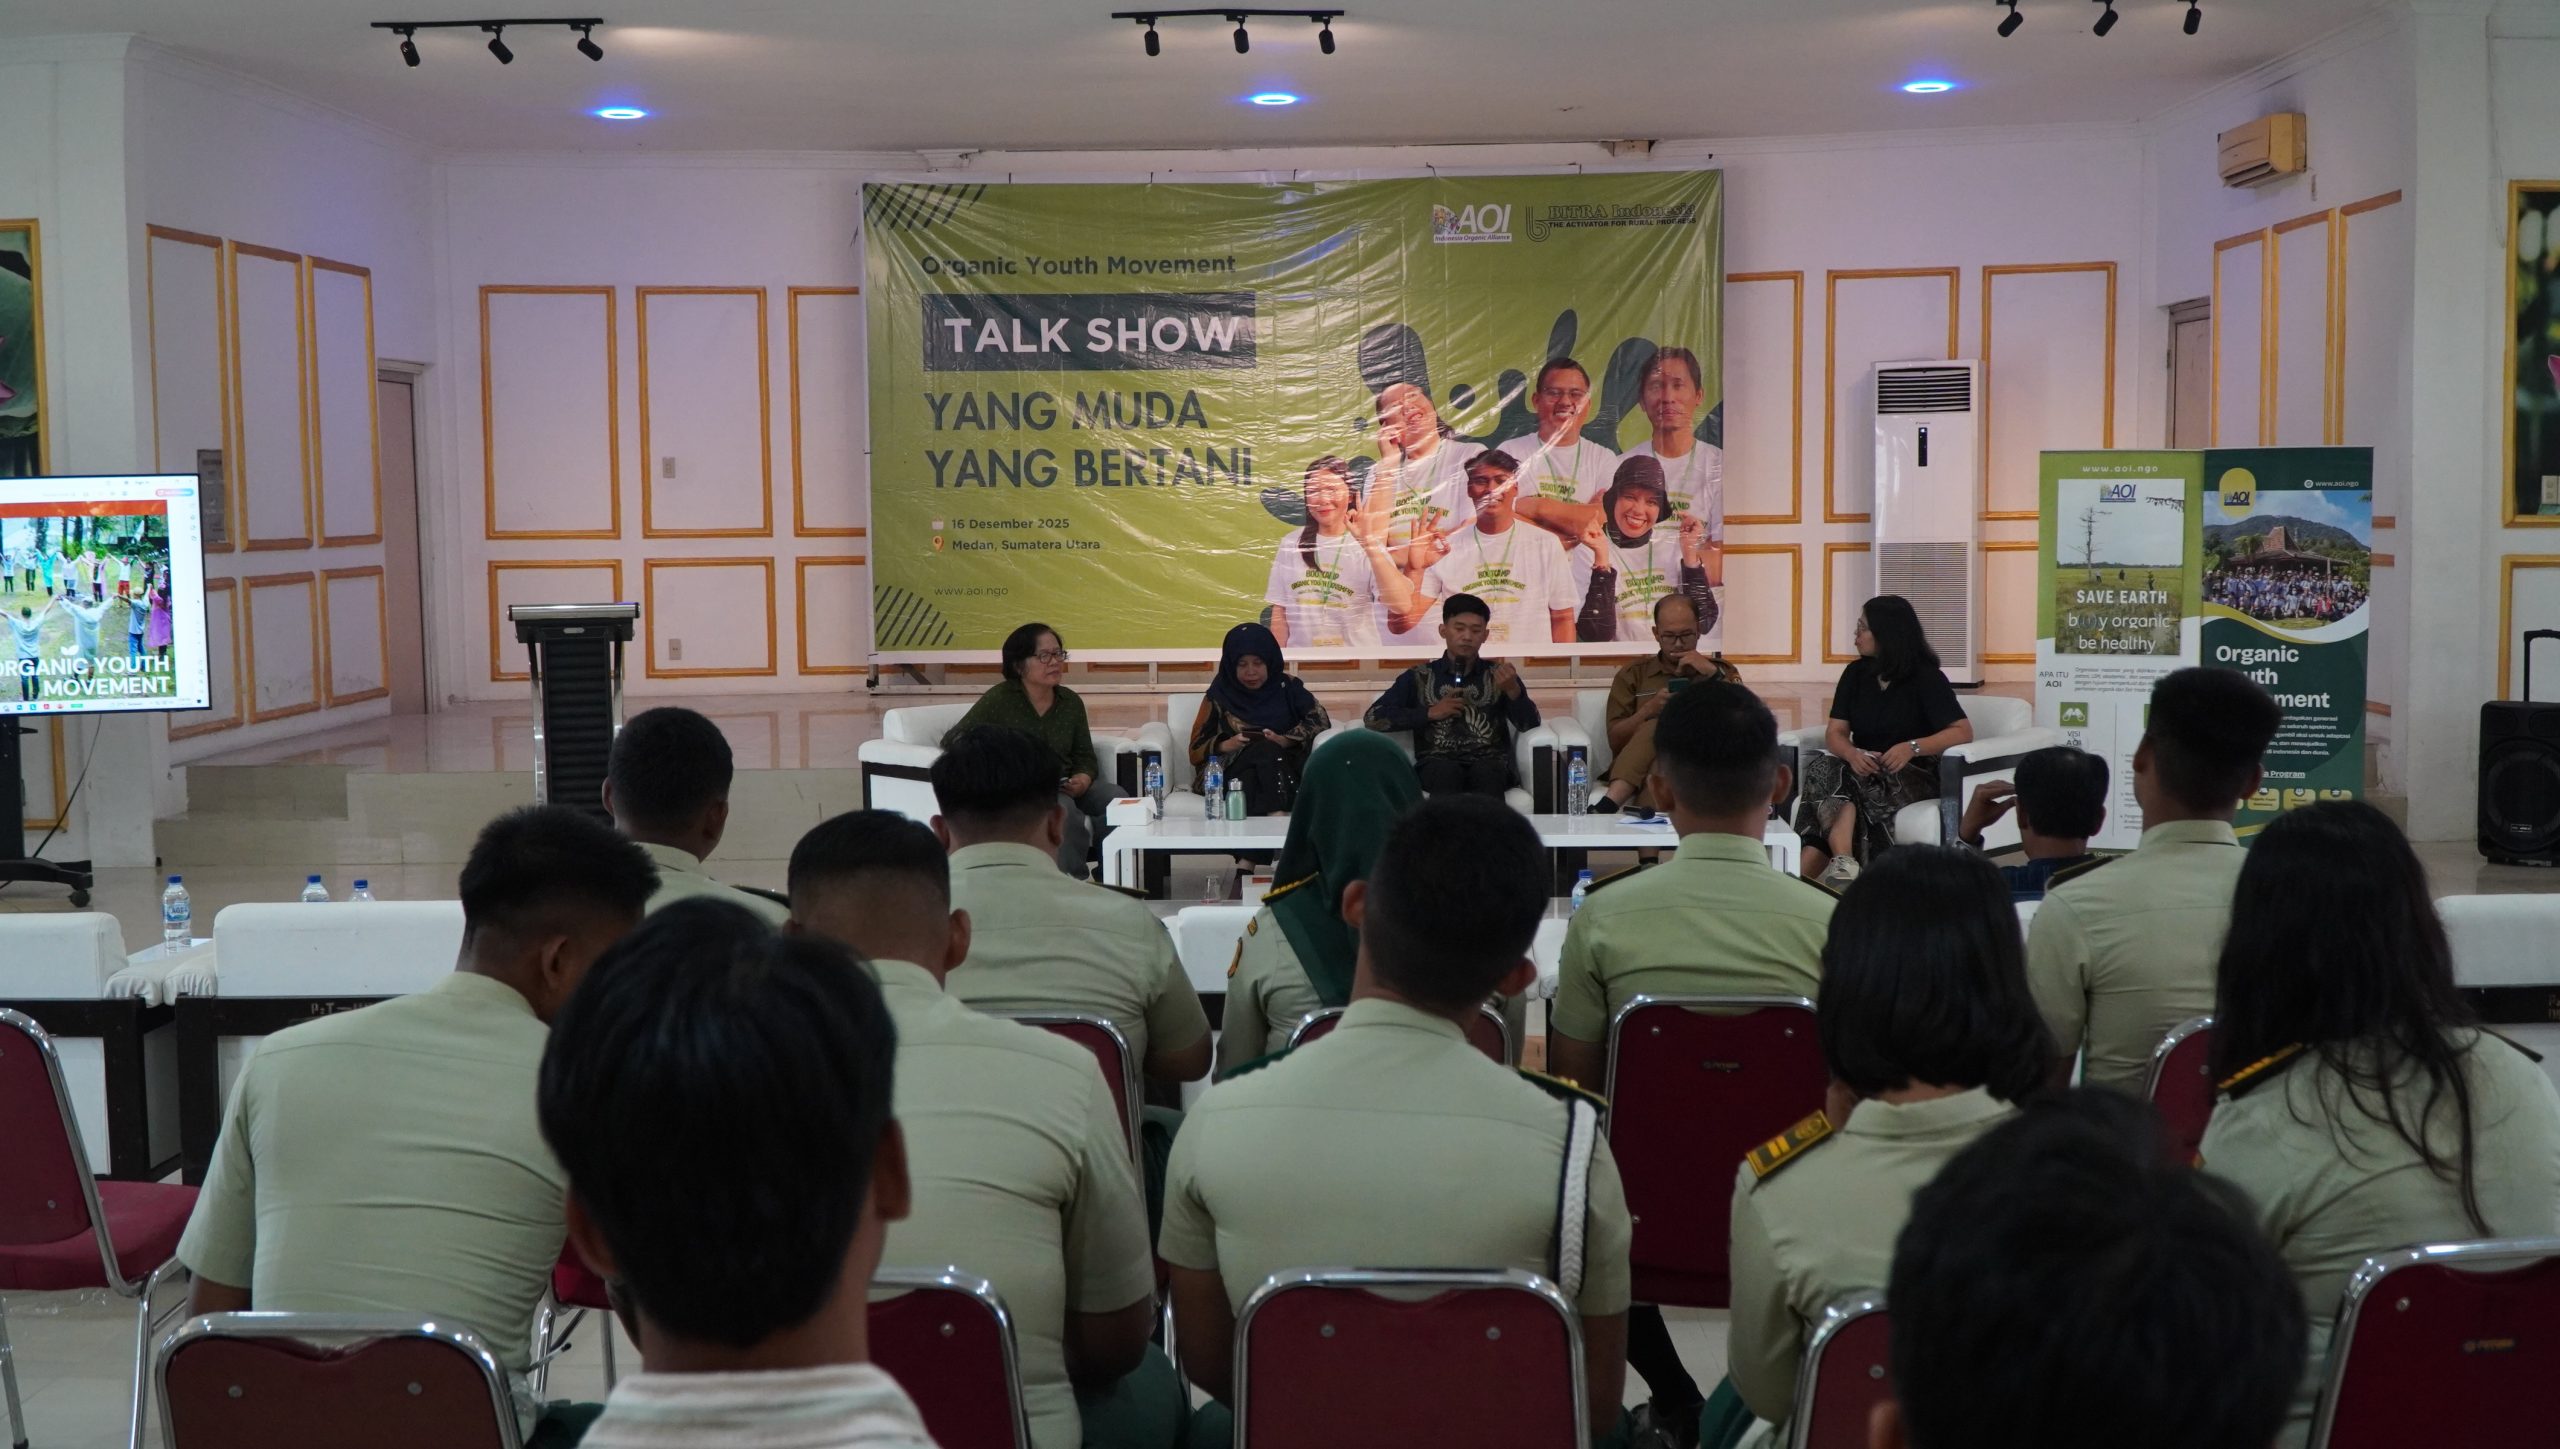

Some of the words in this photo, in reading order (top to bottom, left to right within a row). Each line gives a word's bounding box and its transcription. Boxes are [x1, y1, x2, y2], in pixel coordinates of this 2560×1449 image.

[1459, 204, 1512, 233] AOI
[1549, 205, 1608, 219] BITRA
[1566, 220, 1609, 228] ACTIVATOR
[1611, 219, 1627, 227] FOR
[921, 256, 1018, 277] Organic
[1025, 256, 1098, 274] Youth
[1108, 255, 1236, 275] Movement
[944, 317, 1072, 353] TALK
[1086, 317, 1240, 353] SHOW
[924, 391, 1057, 431] YANG
[1072, 389, 1209, 430] MUDA
[924, 448, 1058, 488] YANG
[1074, 447, 1252, 487] BERTANI
[2082, 465, 2158, 473] www.aoi.ngo
[2111, 484, 2137, 498] AOI
[2315, 480, 2358, 488] www.aoi.ngo
[2232, 491, 2250, 503] AOI
[952, 518, 965, 529] 16
[969, 518, 1034, 530] Desember
[1037, 518, 1070, 529] 2025
[952, 539, 998, 552] Medan,
[1002, 539, 1062, 550] Sumatera
[1066, 538, 1101, 550] Utara
[934, 585, 1009, 596] www.aoi.ngo
[2077, 590, 2114, 604] SAVE
[2120, 590, 2168, 604] EARTH
[2112, 615, 2170, 629] organic
[2079, 635, 2097, 649] be
[2100, 636, 2157, 655] healthy
[2216, 645, 2300, 665] Organic
[0, 656, 89, 678] RGANIC
[94, 655, 169, 674] YOUTH
[2039, 671, 2054, 679] APA
[2245, 668, 2279, 685] uth
[43, 676, 170, 697] MOVEMENT
[2045, 680, 2062, 688] AOI
[2274, 692, 2330, 708] ment
[2271, 770, 2305, 779] Program
